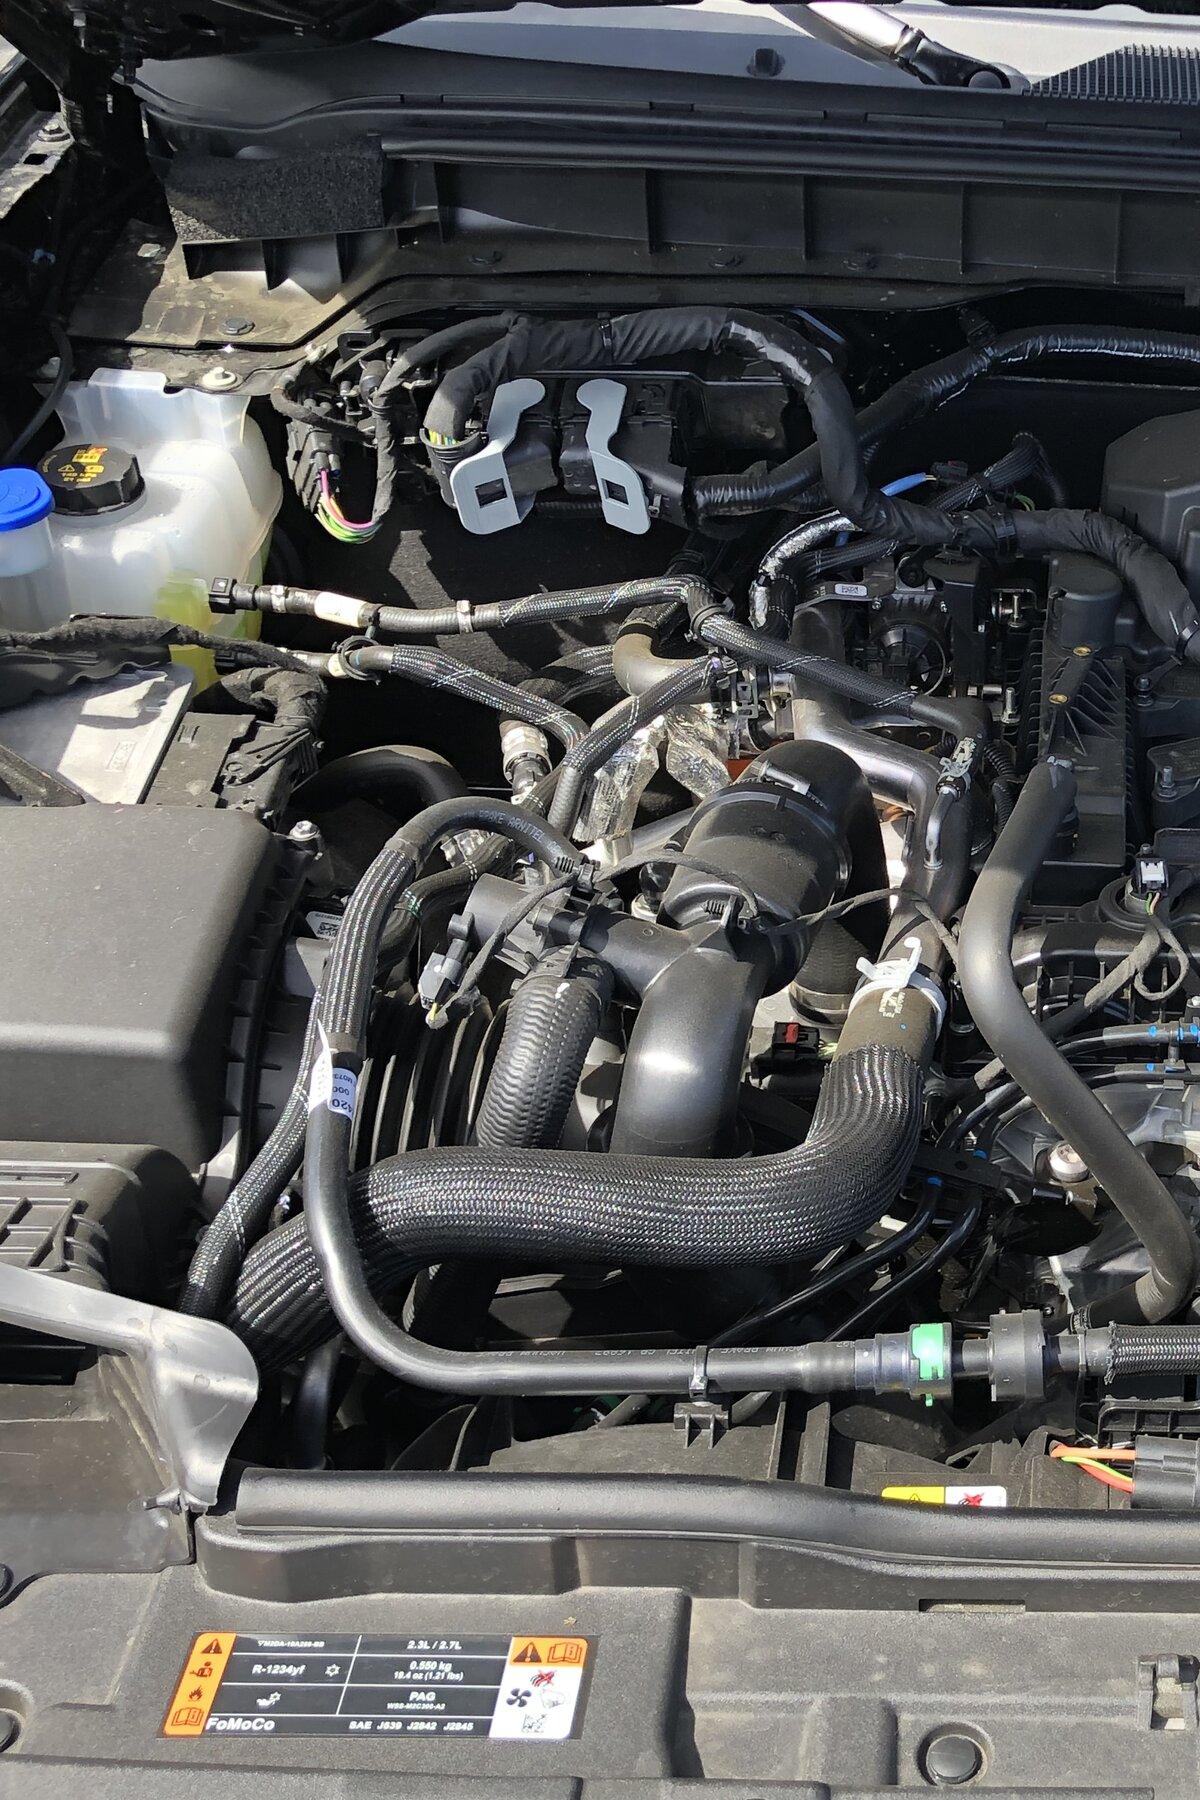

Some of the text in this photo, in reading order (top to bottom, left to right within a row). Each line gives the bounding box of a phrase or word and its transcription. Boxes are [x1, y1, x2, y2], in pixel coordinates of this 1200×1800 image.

[406, 1639, 431, 1650] 2.3L
[438, 1640, 463, 1650] 2.7L
[251, 1664, 307, 1676] R-1234yf
[409, 1660, 453, 1672] 0.550 kg
[409, 1691, 437, 1702] PAG
[205, 1717, 276, 1731] FoMoCo
[348, 1720, 373, 1730] SAE
